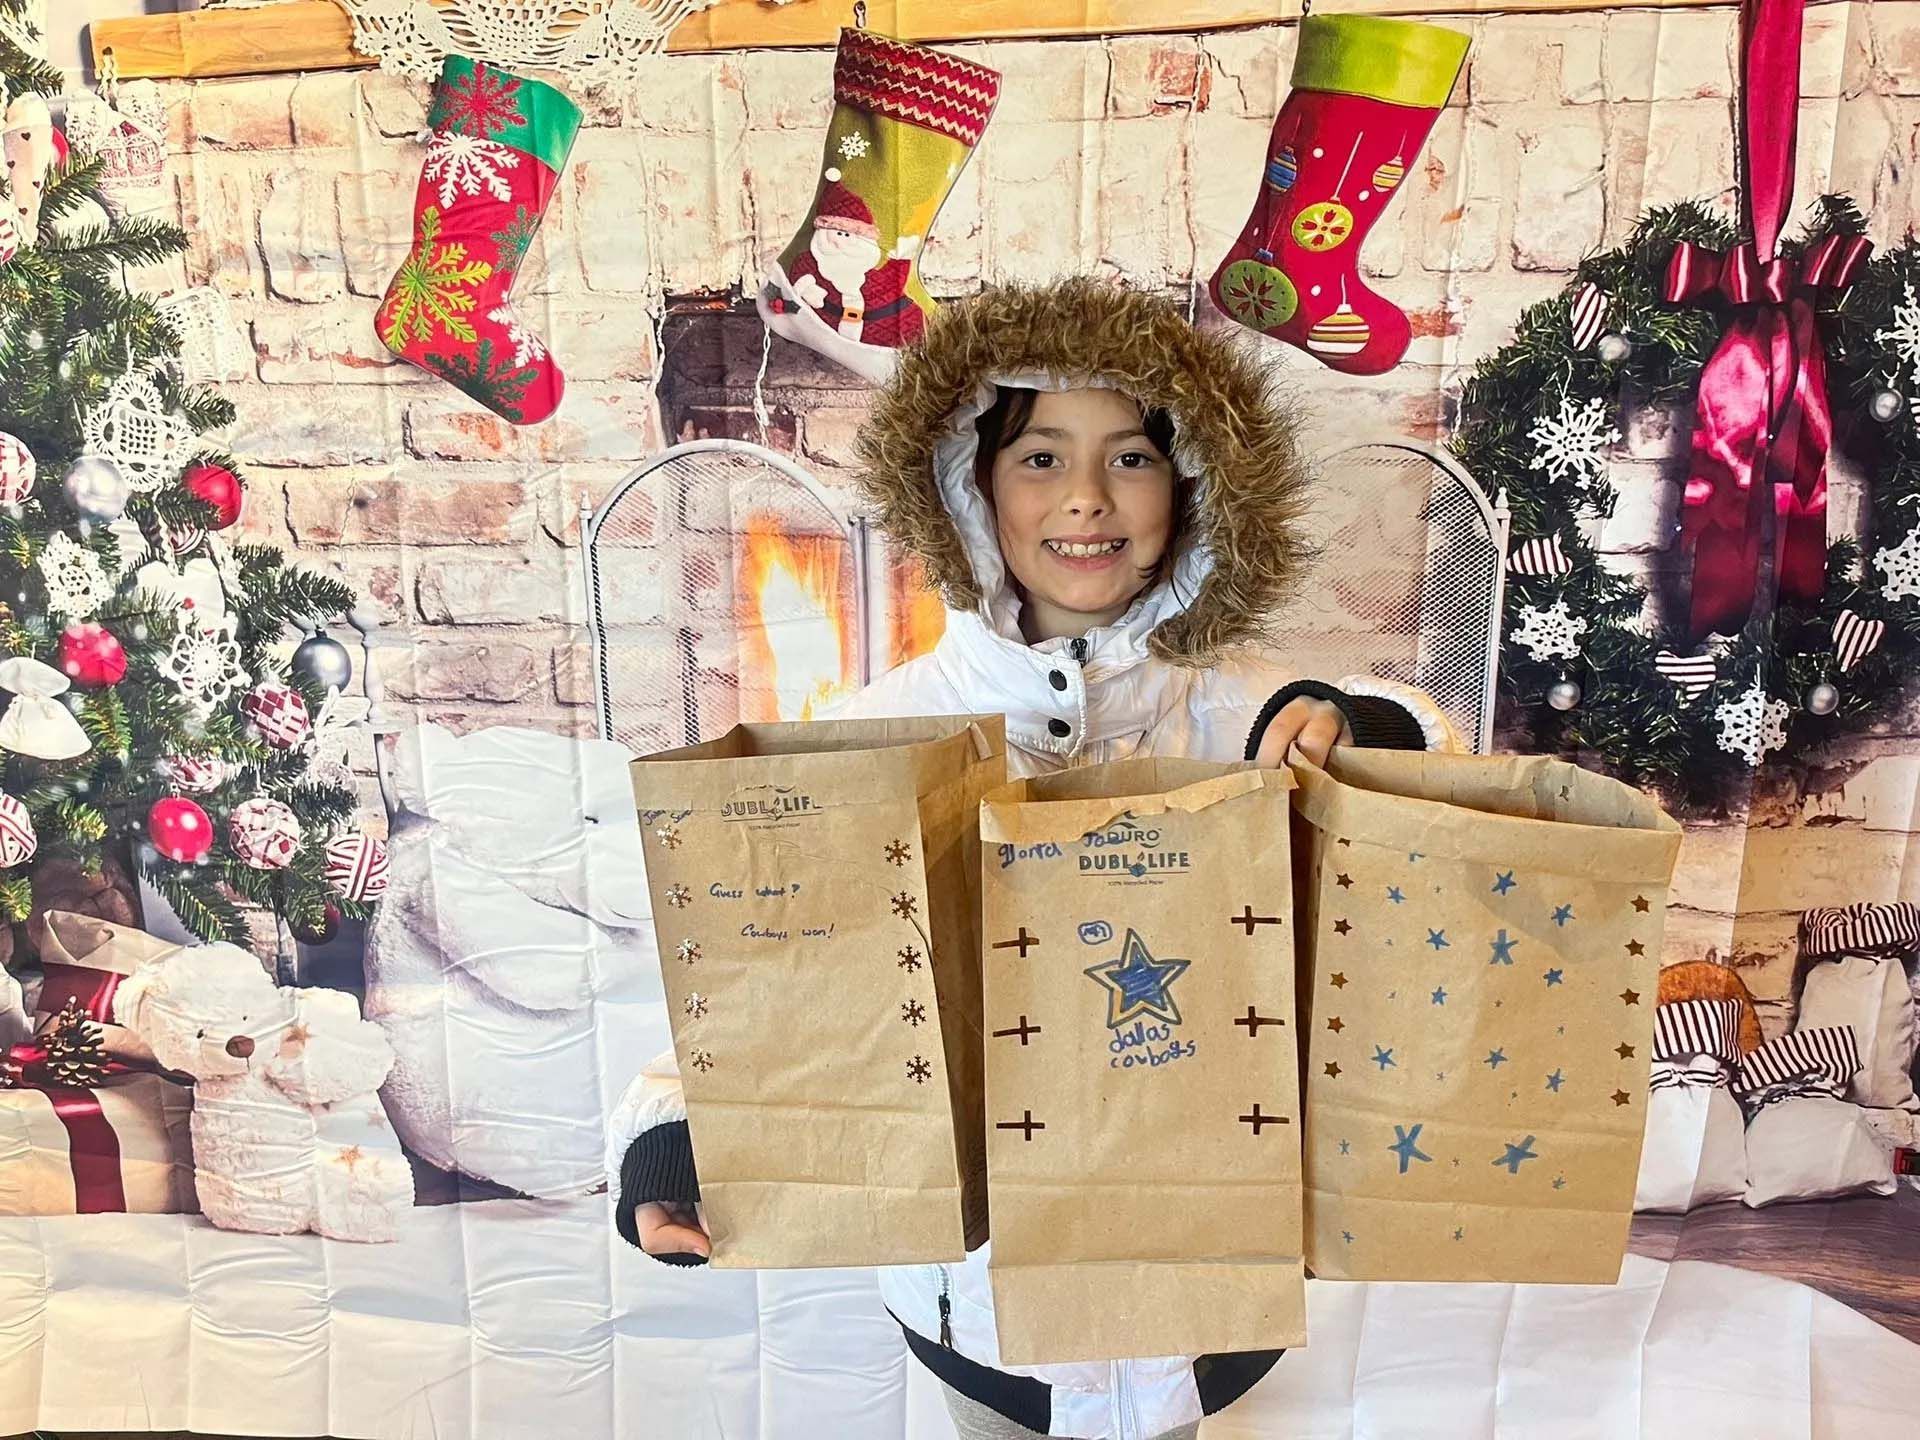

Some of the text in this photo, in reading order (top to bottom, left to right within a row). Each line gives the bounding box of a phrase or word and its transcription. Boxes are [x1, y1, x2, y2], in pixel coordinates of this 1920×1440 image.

[783, 796, 824, 813] LIF
[1079, 852, 1191, 871] DUBL LIFE
[709, 882, 744, 899] Guess
[741, 923, 835, 939] Cowboys won!
[1109, 1022, 1170, 1053] dallas
